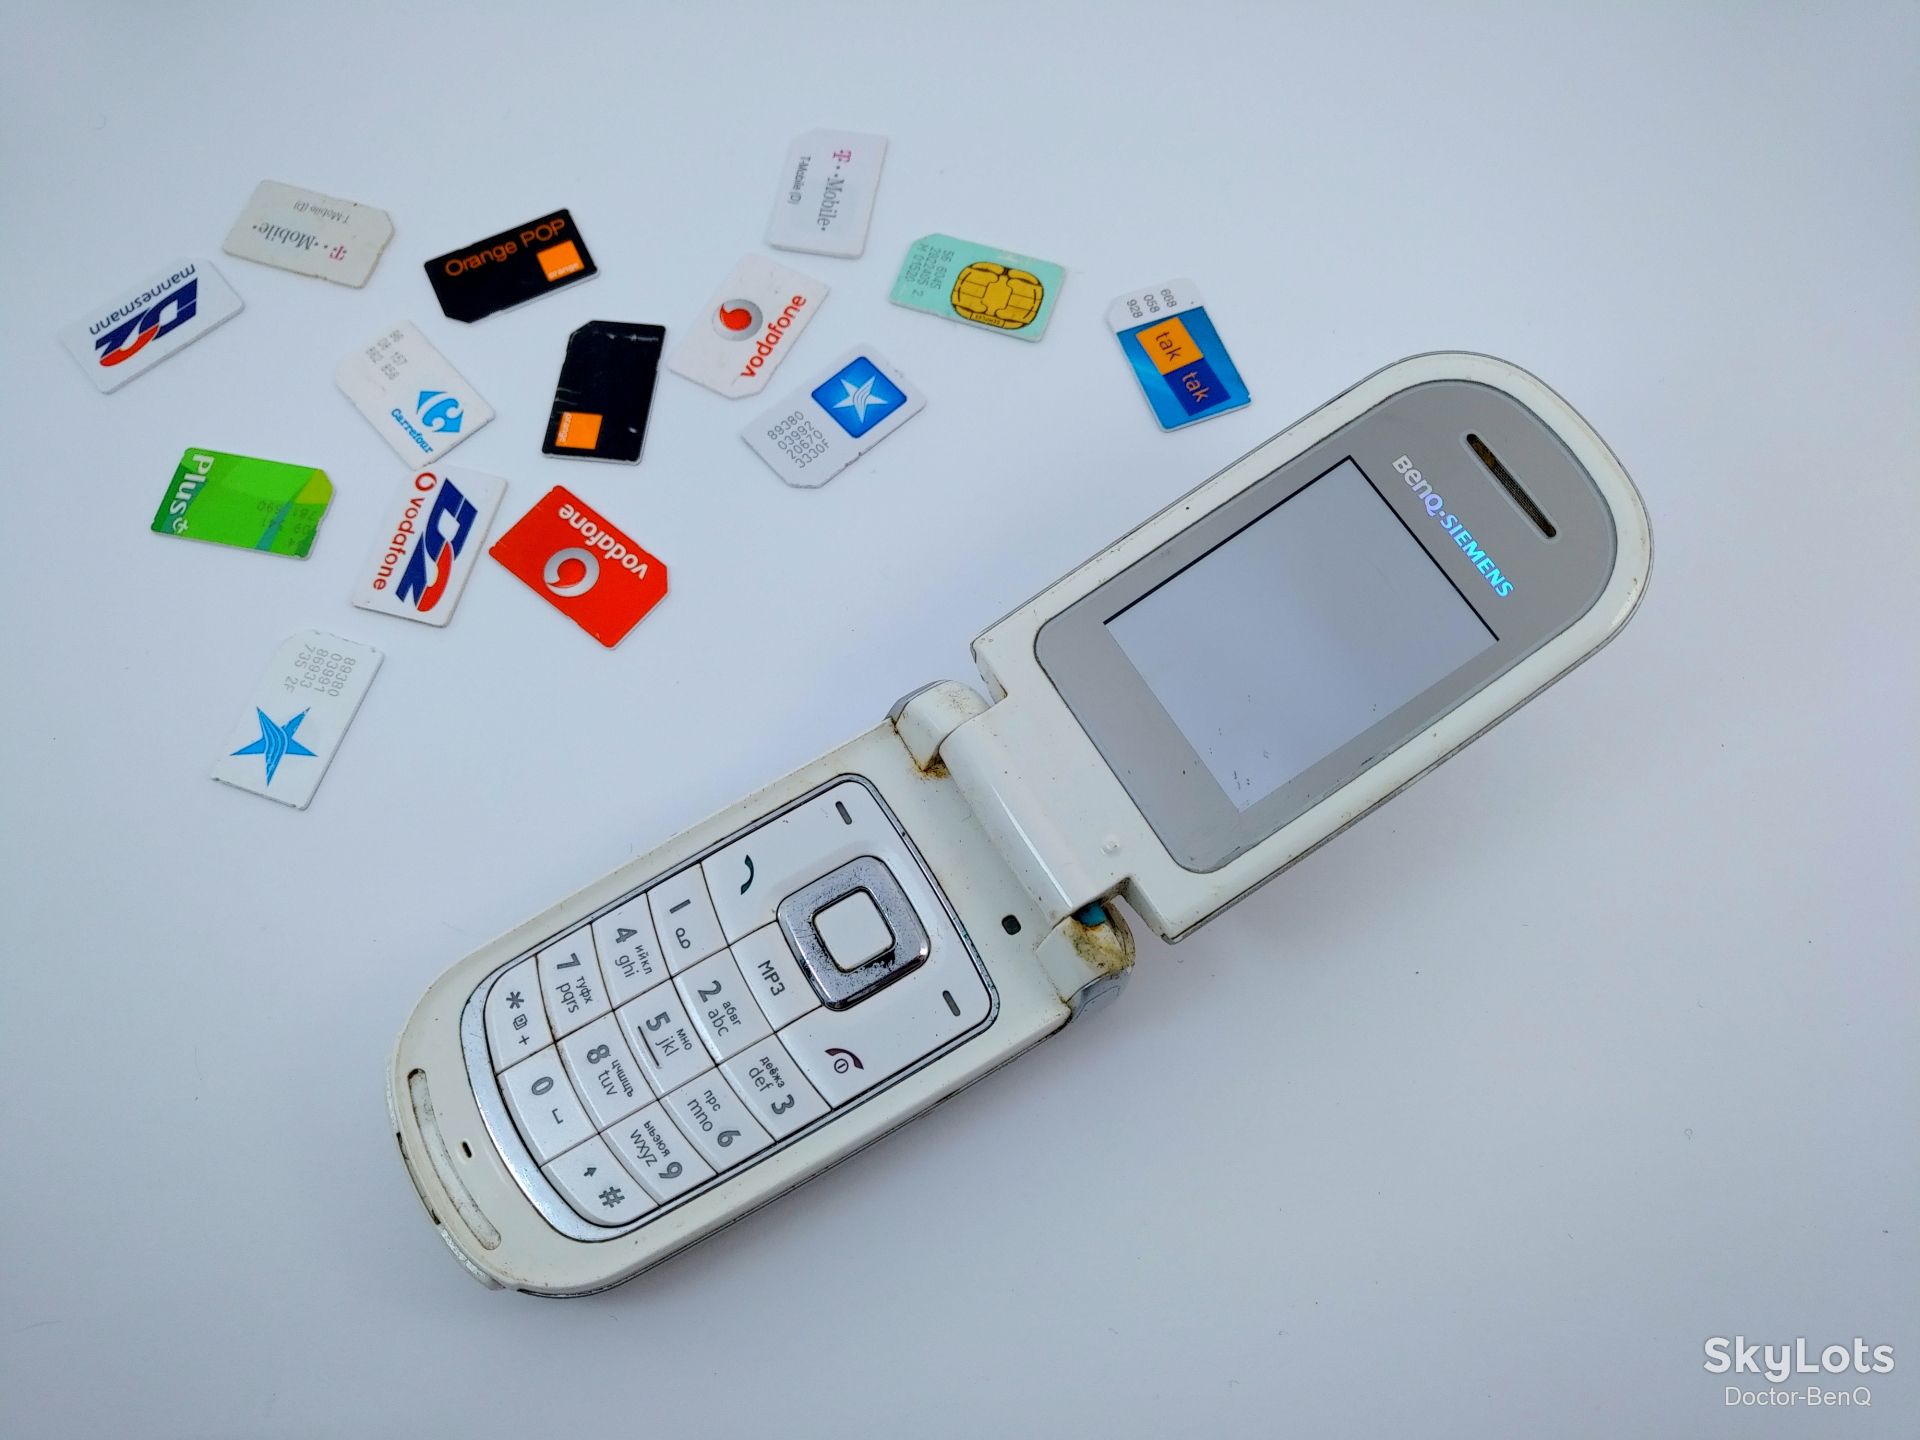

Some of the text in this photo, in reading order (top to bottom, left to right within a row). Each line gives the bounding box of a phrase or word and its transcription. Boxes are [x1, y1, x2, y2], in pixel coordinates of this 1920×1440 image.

[444, 217, 566, 276] Orange POP
[548, 262, 580, 279] orange
[89, 263, 196, 335] mannesmann
[1126, 298, 1144, 319] 928
[1143, 293, 1161, 314] 058
[740, 294, 807, 378] vodafone
[1155, 331, 1183, 362] tak
[1181, 371, 1210, 404] tak
[391, 407, 434, 454] Carrefour
[767, 410, 805, 441] 89380
[777, 420, 815, 450] 03992
[785, 430, 824, 460] 20670
[794, 438, 831, 469] 3330F
[170, 453, 215, 516] Plus
[373, 496, 426, 591] vodafone
[558, 503, 649, 580] vodafone
[284, 643, 316, 694] 735 2F
[299, 648, 329, 689] 86933
[314, 653, 343, 693] 03991
[327, 656, 357, 697] 89380
[615, 927, 638, 944] 4
[556, 952, 581, 970] 7
[614, 954, 639, 978] ghi
[634, 944, 653, 975] ийкл
[575, 975, 593, 1005] туфх
[697, 979, 722, 1003] 2
[757, 959, 786, 997] MP3
[555, 981, 580, 1014] pqrs
[645, 1011, 671, 1032] 5
[707, 1008, 729, 1037] abc
[722, 1000, 742, 1026] абвг
[586, 1044, 610, 1065] 8
[655, 1035, 680, 1057] jkl
[676, 1028, 693, 1051] мно
[531, 1076, 554, 1096] 0
[598, 1069, 618, 1096] tuv
[611, 1059, 635, 1098] цчшщъ
[748, 1066, 774, 1093] def
[759, 1056, 785, 1089] деёжз
[687, 1098, 714, 1132] mno
[703, 1089, 721, 1112] прс
[771, 1093, 795, 1115] 3
[630, 1128, 658, 1168] wxyz
[643, 1120, 671, 1158] ыьэюя
[717, 1129, 742, 1148] 6
[658, 1161, 683, 1179] 9
[598, 1186, 626, 1208] #
